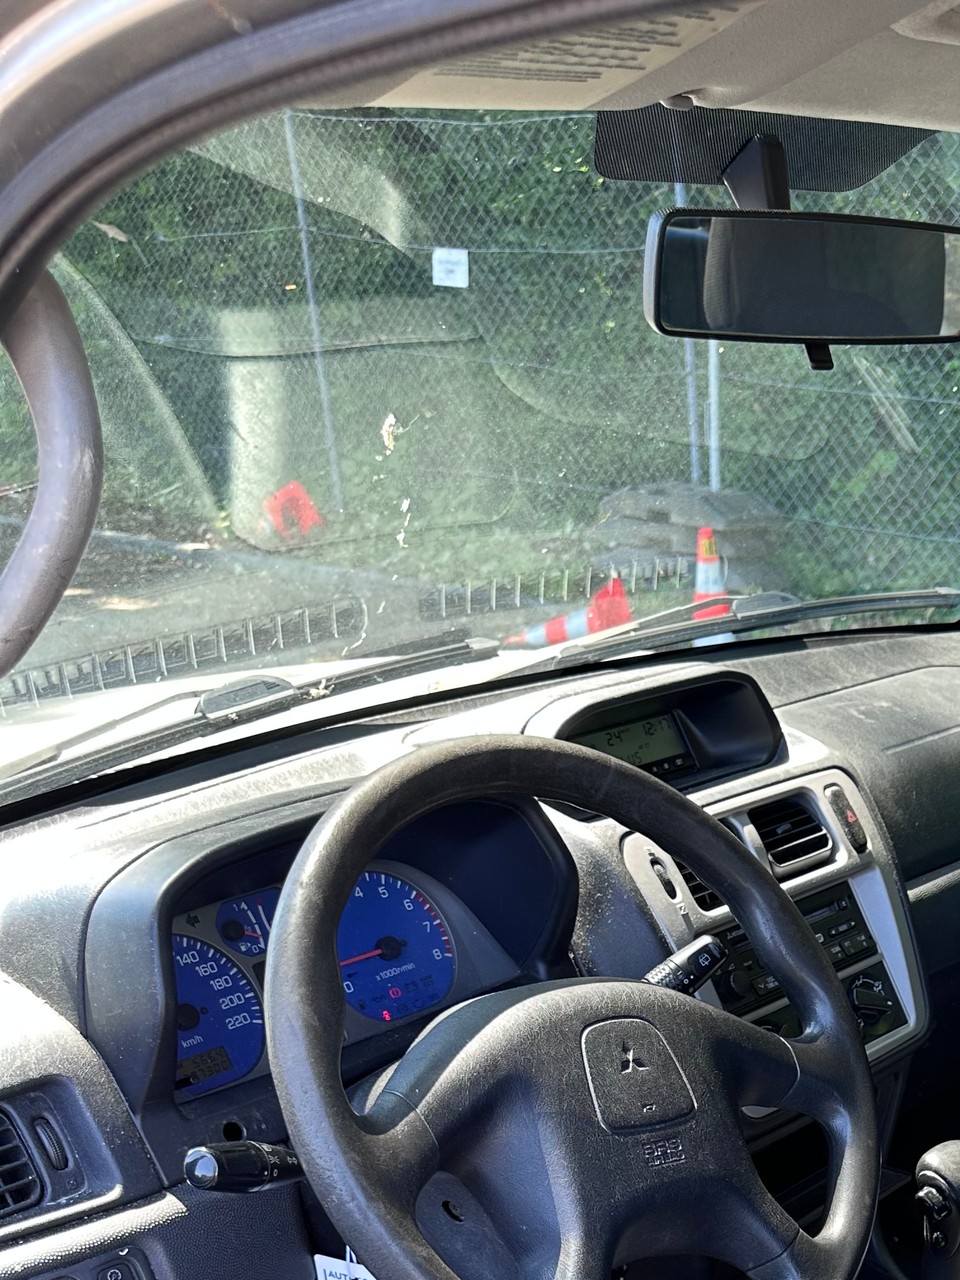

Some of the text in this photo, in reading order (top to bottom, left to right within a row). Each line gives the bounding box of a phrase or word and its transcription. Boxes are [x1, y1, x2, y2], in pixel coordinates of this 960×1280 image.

[642, 717, 671, 736] 12:17
[354, 887, 364, 898] 4
[378, 886, 389, 898] 5
[403, 899, 414, 911] 6
[422, 921, 431, 933] 7
[176, 950, 200, 967] 140
[432, 948, 443, 960] 8
[195, 961, 218, 977] 160
[209, 975, 233, 991] 180
[343, 981, 354, 993] 0
[219, 992, 245, 1010] 200
[225, 1012, 251, 1030] 220
[181, 1035, 204, 1049] km/h
